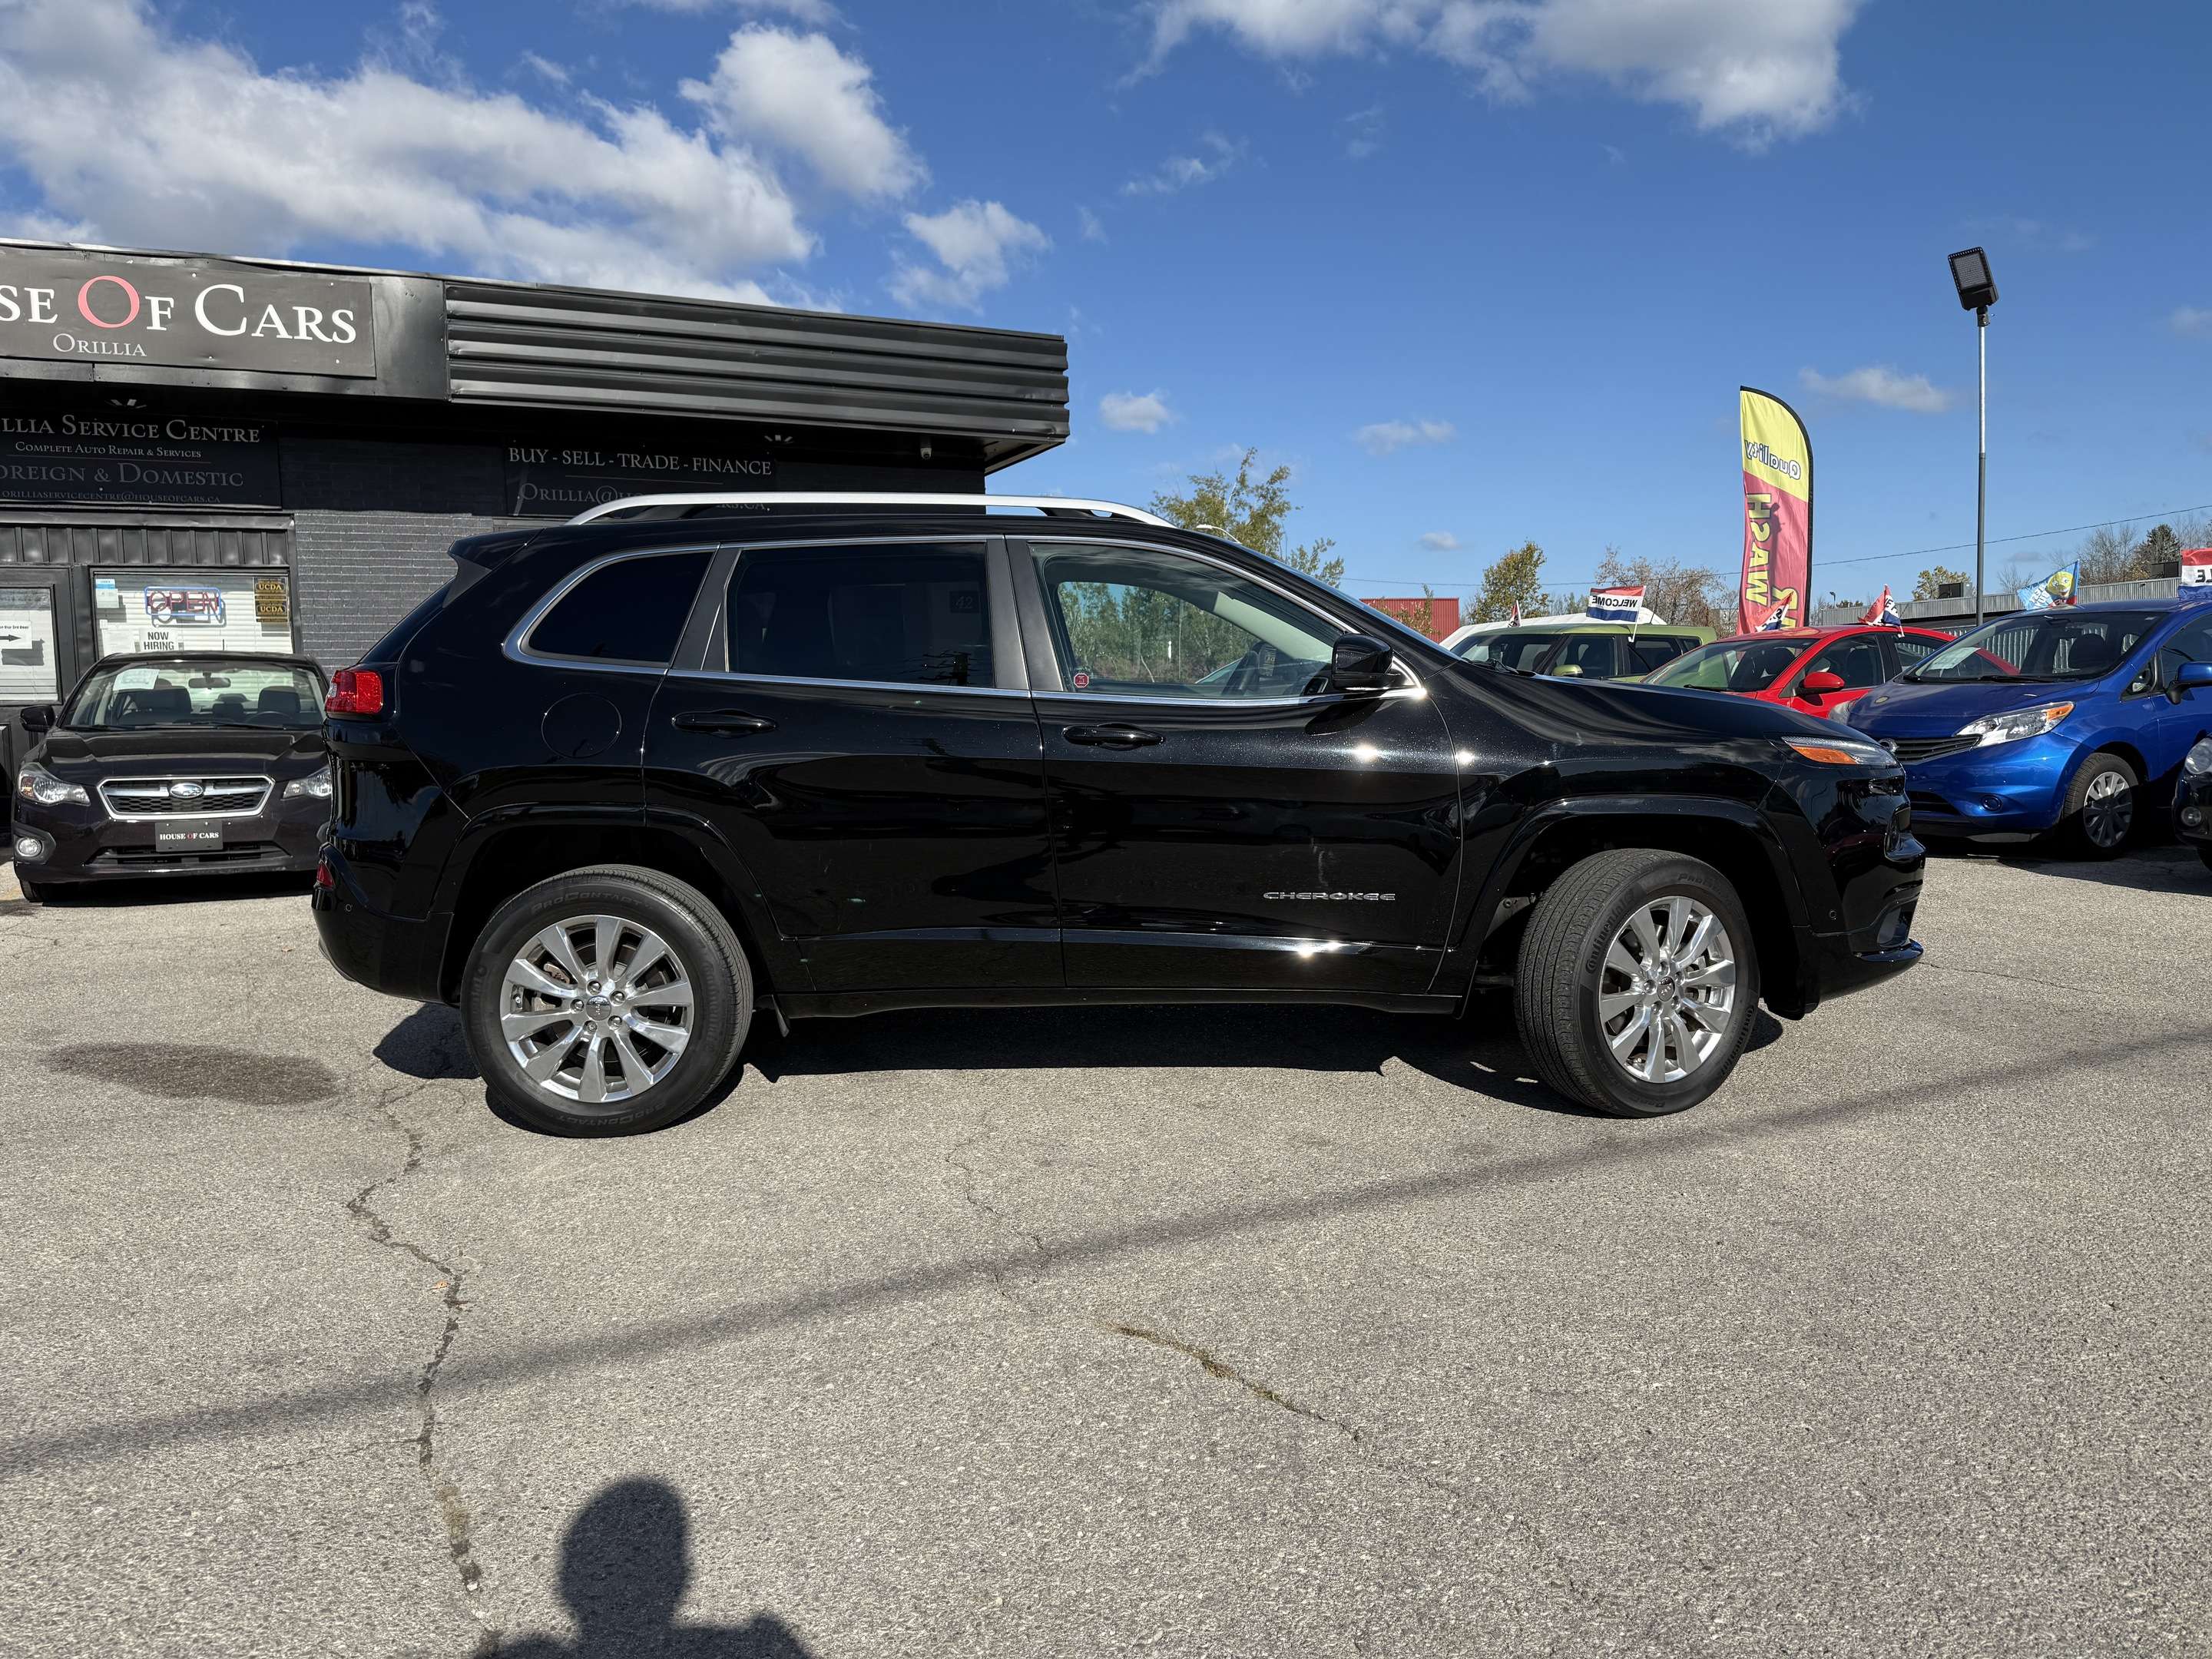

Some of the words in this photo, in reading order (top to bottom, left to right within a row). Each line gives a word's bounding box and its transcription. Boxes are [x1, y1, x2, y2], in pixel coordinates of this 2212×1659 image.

[0, 285, 58, 323] SE
[78, 275, 174, 331] OF
[194, 283, 356, 344] CARS
[53, 333, 147, 357] ORILLIA
[61, 414, 160, 439] SERVICE
[165, 419, 260, 443] CENTRE
[15, 441, 73, 454] COMPLETE
[75, 443, 106, 455] AUTO
[108, 445, 144, 456] REPAIR
[156, 446, 202, 459] SERVICES
[509, 447, 549, 463] BUY
[562, 450, 606, 467] SELL
[618, 453, 680, 471] TRADE
[692, 458, 772, 475] FINANCE
[94, 468, 111, 483] &
[117, 462, 245, 487] DOMESTIC
[149, 591, 218, 612] OPEN
[144, 641, 174, 651] HIRING
[147, 631, 169, 641] NOW
[1263, 892, 1396, 901] CHEROKEE
